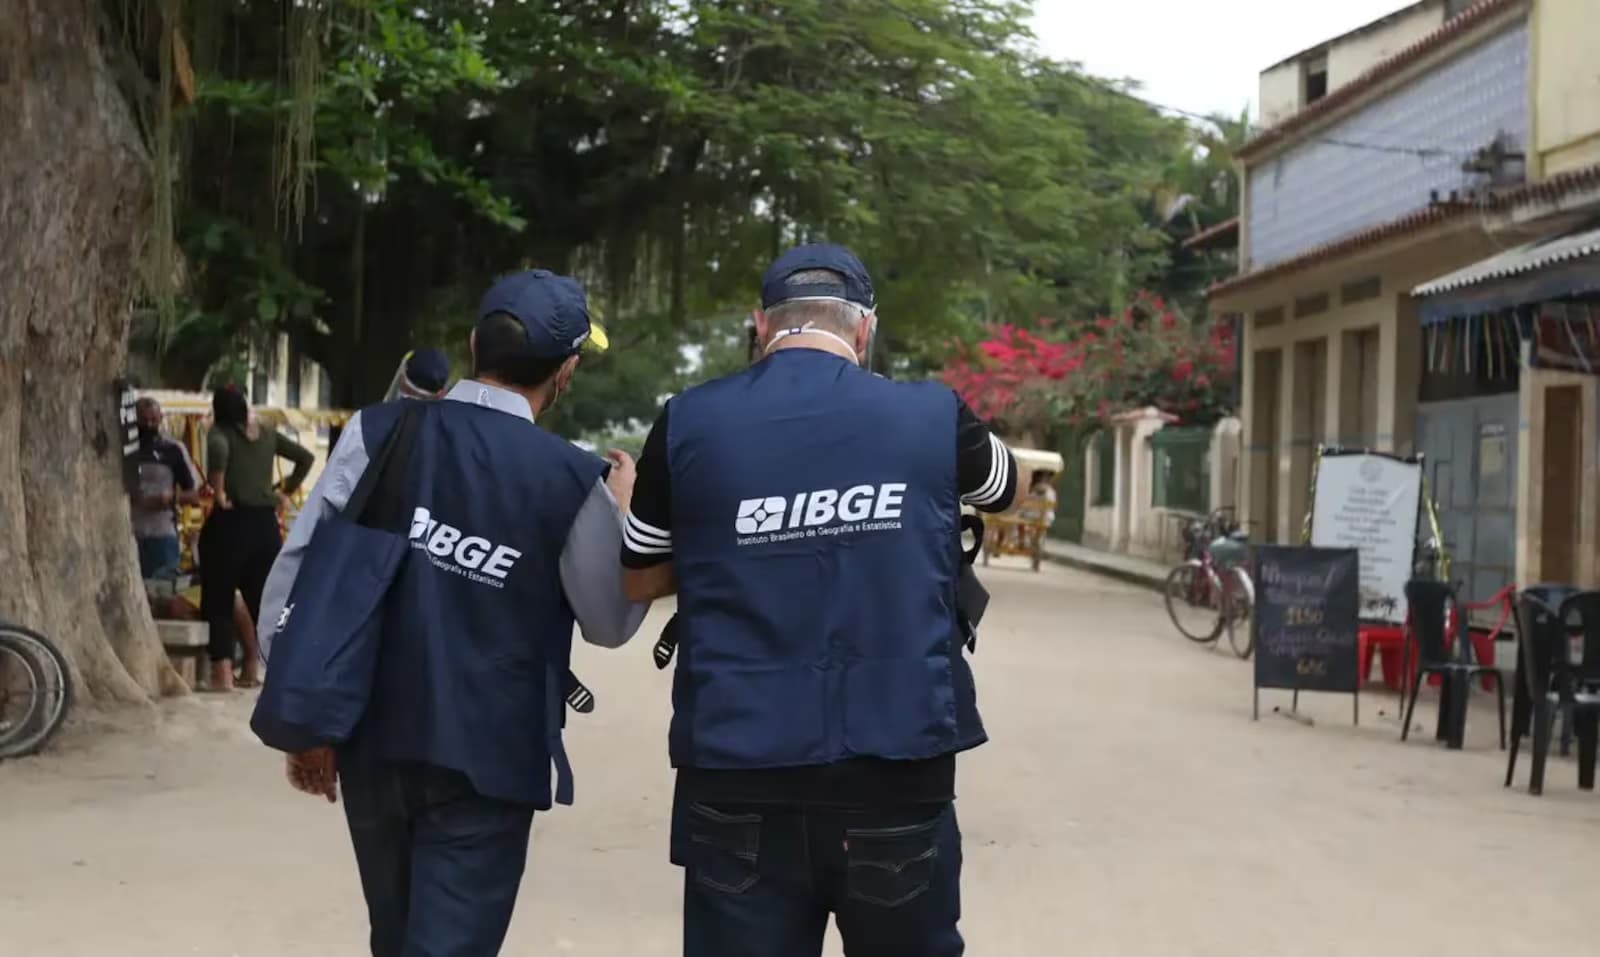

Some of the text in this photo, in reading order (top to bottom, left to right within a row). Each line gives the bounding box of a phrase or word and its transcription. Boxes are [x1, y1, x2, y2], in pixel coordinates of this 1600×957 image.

[788, 483, 907, 528] IBGE
[737, 535, 768, 546] Instituto
[769, 531, 804, 542] Brasileiro
[806, 528, 816, 537] de
[817, 524, 854, 536] Geografia
